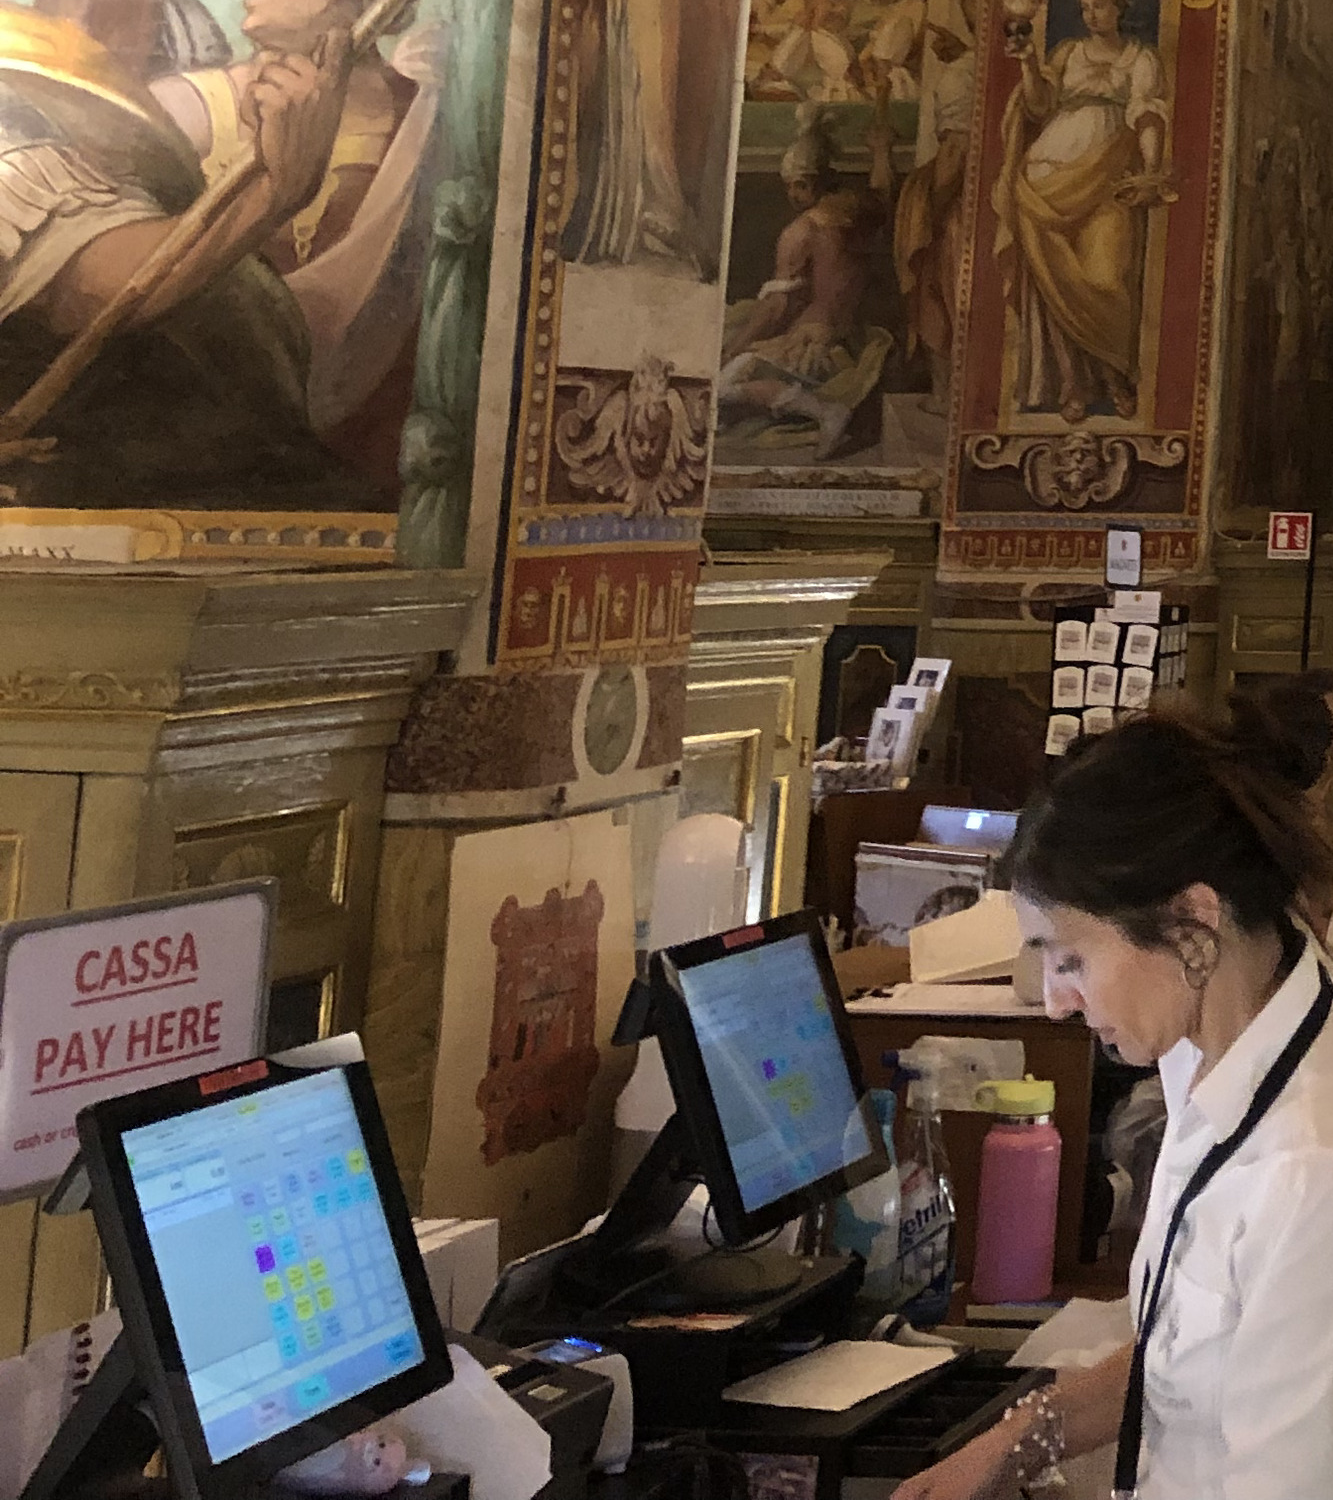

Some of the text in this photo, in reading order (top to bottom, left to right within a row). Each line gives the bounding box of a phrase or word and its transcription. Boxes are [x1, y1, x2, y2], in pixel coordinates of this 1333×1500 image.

[75, 932, 199, 994] CASSA
[34, 1000, 223, 1083] PAY HERE
[13, 1132, 42, 1151] cash
[44, 1131, 58, 1143] or
